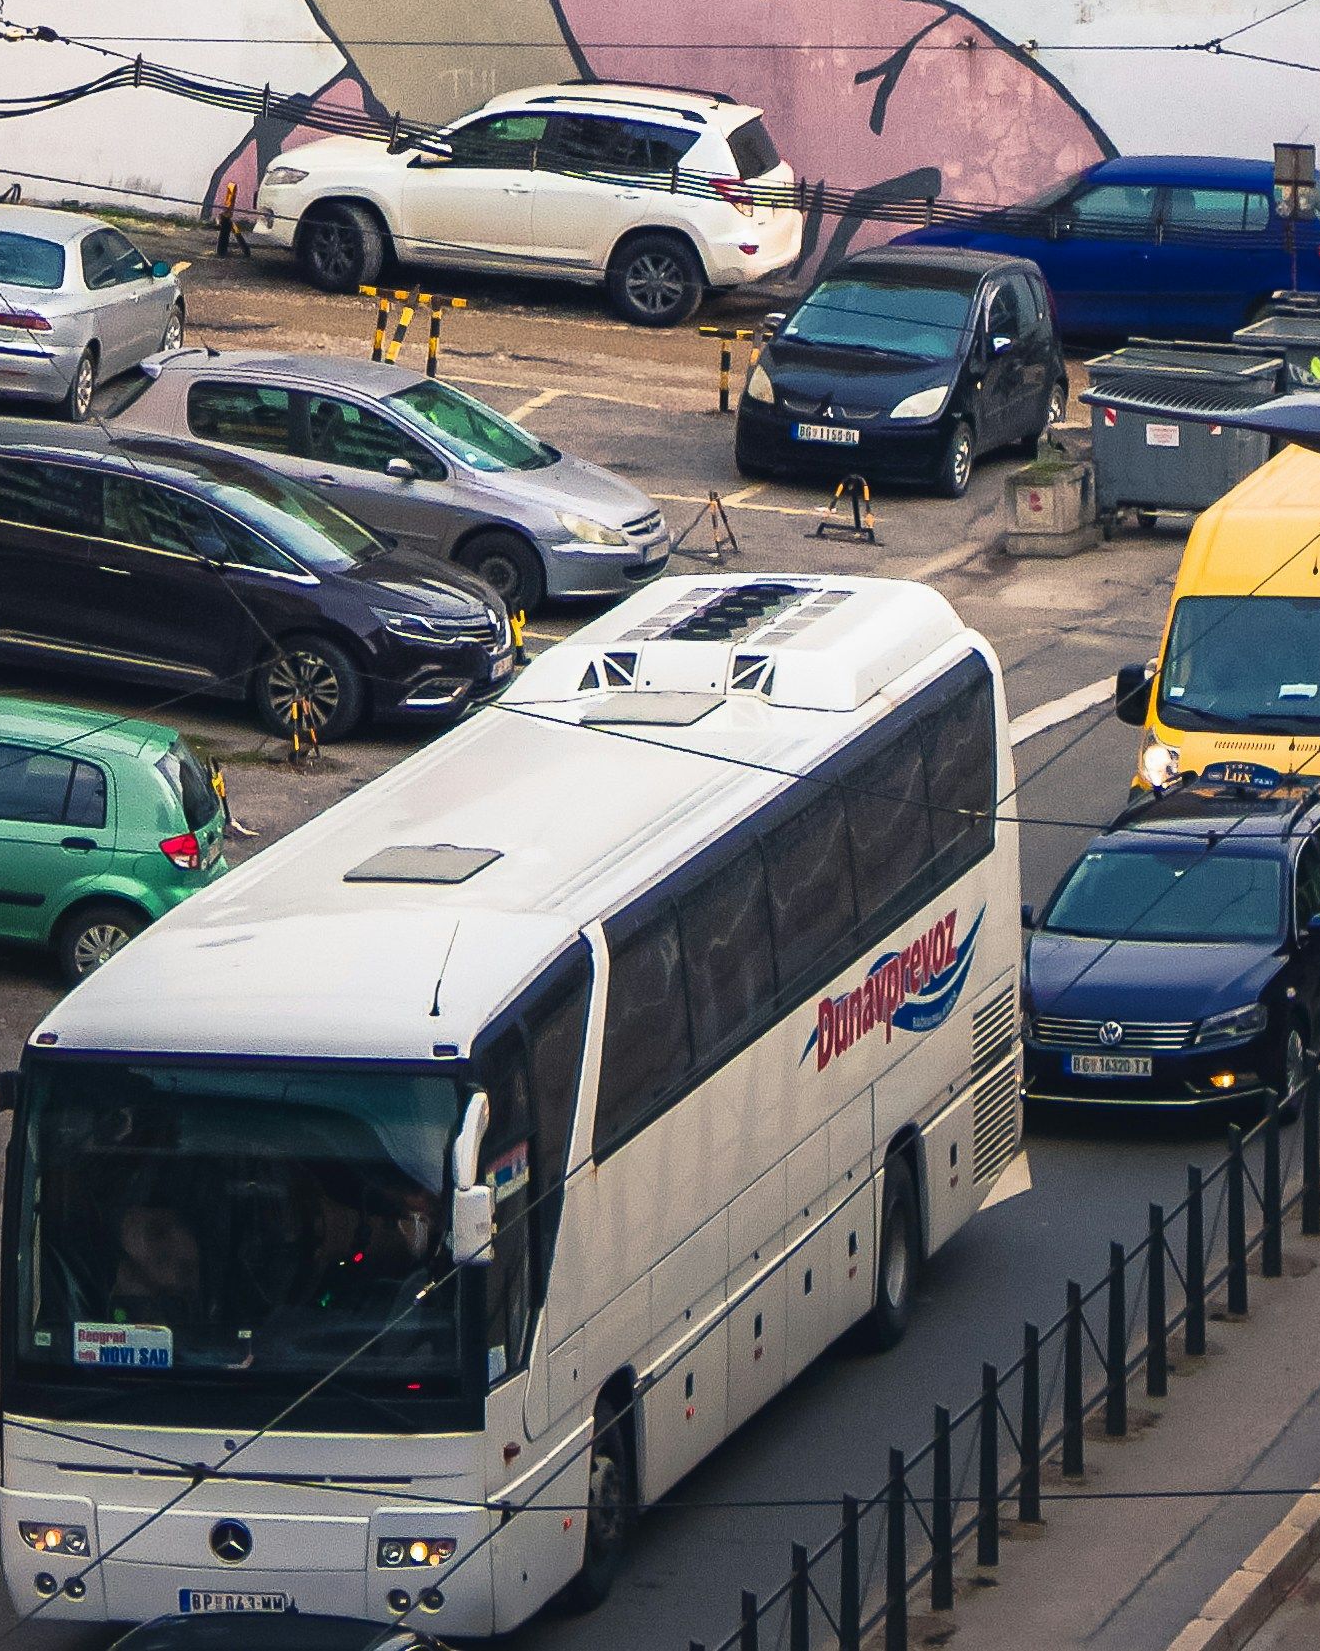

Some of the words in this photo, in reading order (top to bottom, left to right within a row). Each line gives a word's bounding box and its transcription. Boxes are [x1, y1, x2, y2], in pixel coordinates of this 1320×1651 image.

[817, 908, 957, 1072] Dunavprevoz
[99, 1346, 135, 1363] NOVI
[138, 1347, 169, 1366] SAD
